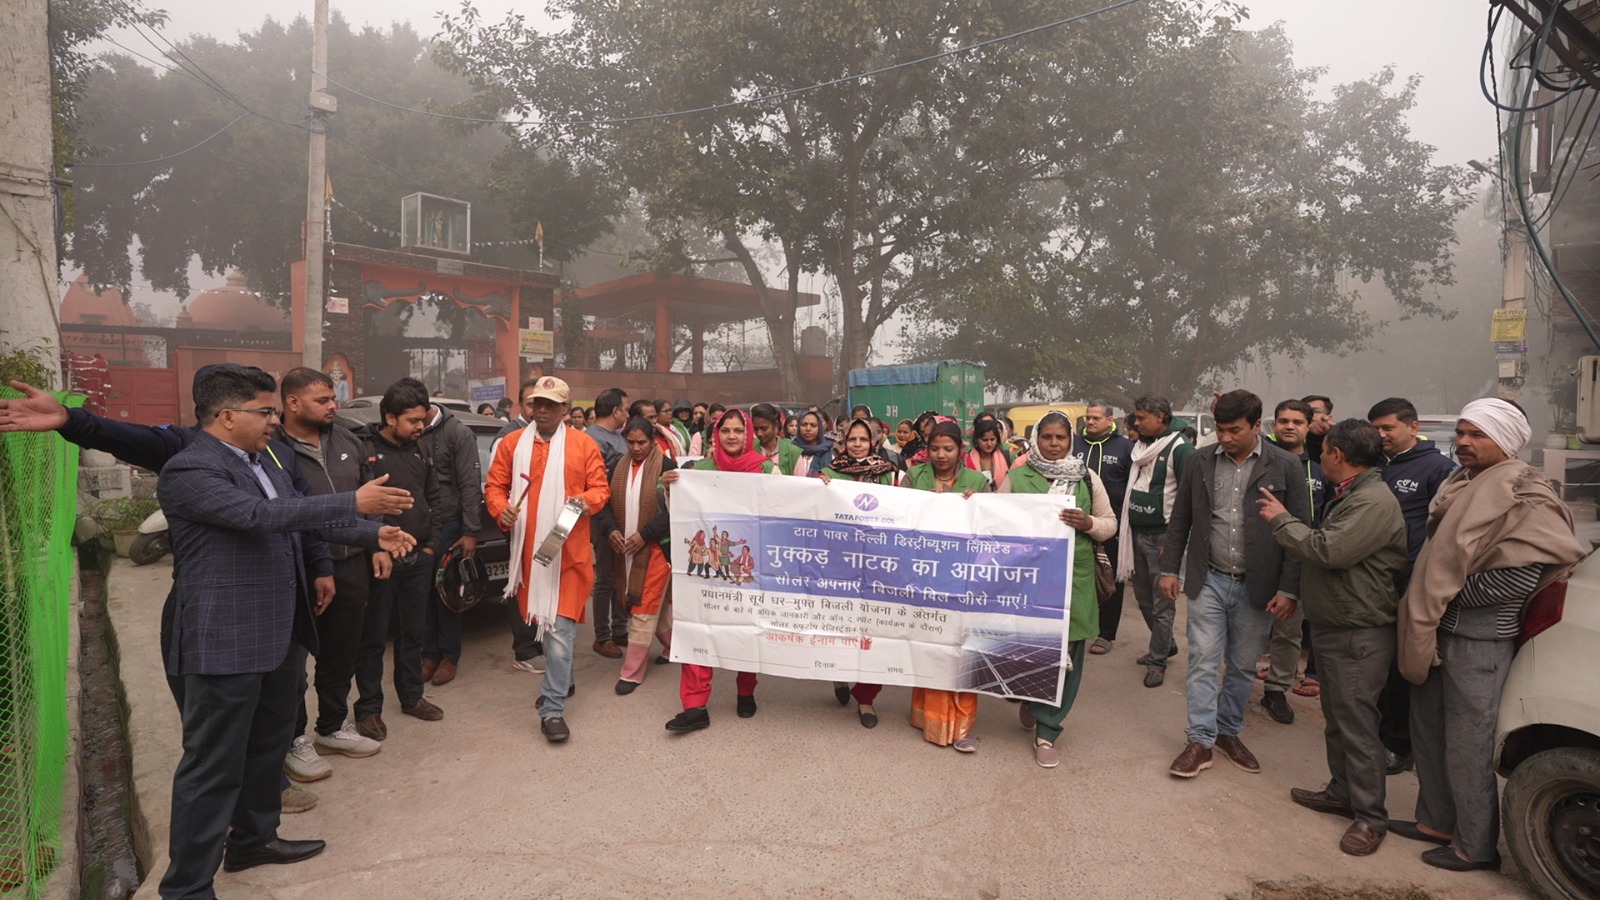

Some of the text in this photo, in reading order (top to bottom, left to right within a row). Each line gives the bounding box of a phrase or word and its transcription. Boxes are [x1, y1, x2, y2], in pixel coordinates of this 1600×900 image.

[834, 513, 854, 521] TATA
[793, 527, 1011, 555] टाटा पावर दिल्ली डिस्ट्रीब्यूशन लिमिटेड
[765, 545, 1040, 584] नुक्कड़ नाटक का आयोजन
[775, 571, 811, 587] सोलर
[872, 580, 915, 598] बिजली
[923, 586, 948, 603] बिल
[958, 590, 988, 606] जीरो
[997, 593, 1028, 609] पाएं!
[701, 588, 743, 602] प्रधानमंत्री
[749, 592, 765, 606] सूर्य
[821, 598, 853, 611] बिजली
[860, 603, 891, 616] योजना
[897, 606, 907, 617] के
[912, 609, 947, 623] अंतर्गत
[703, 602, 720, 611] सोलर
[723, 604, 730, 612] के
[733, 606, 744, 614] बारे
[757, 608, 777, 617] अधिक
[780, 610, 809, 620] जानकारी
[812, 612, 826, 621] और
[908, 620, 915, 629] के
[766, 631, 804, 644] आकर्षक
[810, 634, 836, 647] ईनाम
[770, 620, 789, 630] सोलर
[793, 621, 818, 631] रूफटॉप
[859, 626, 869, 634] पर
